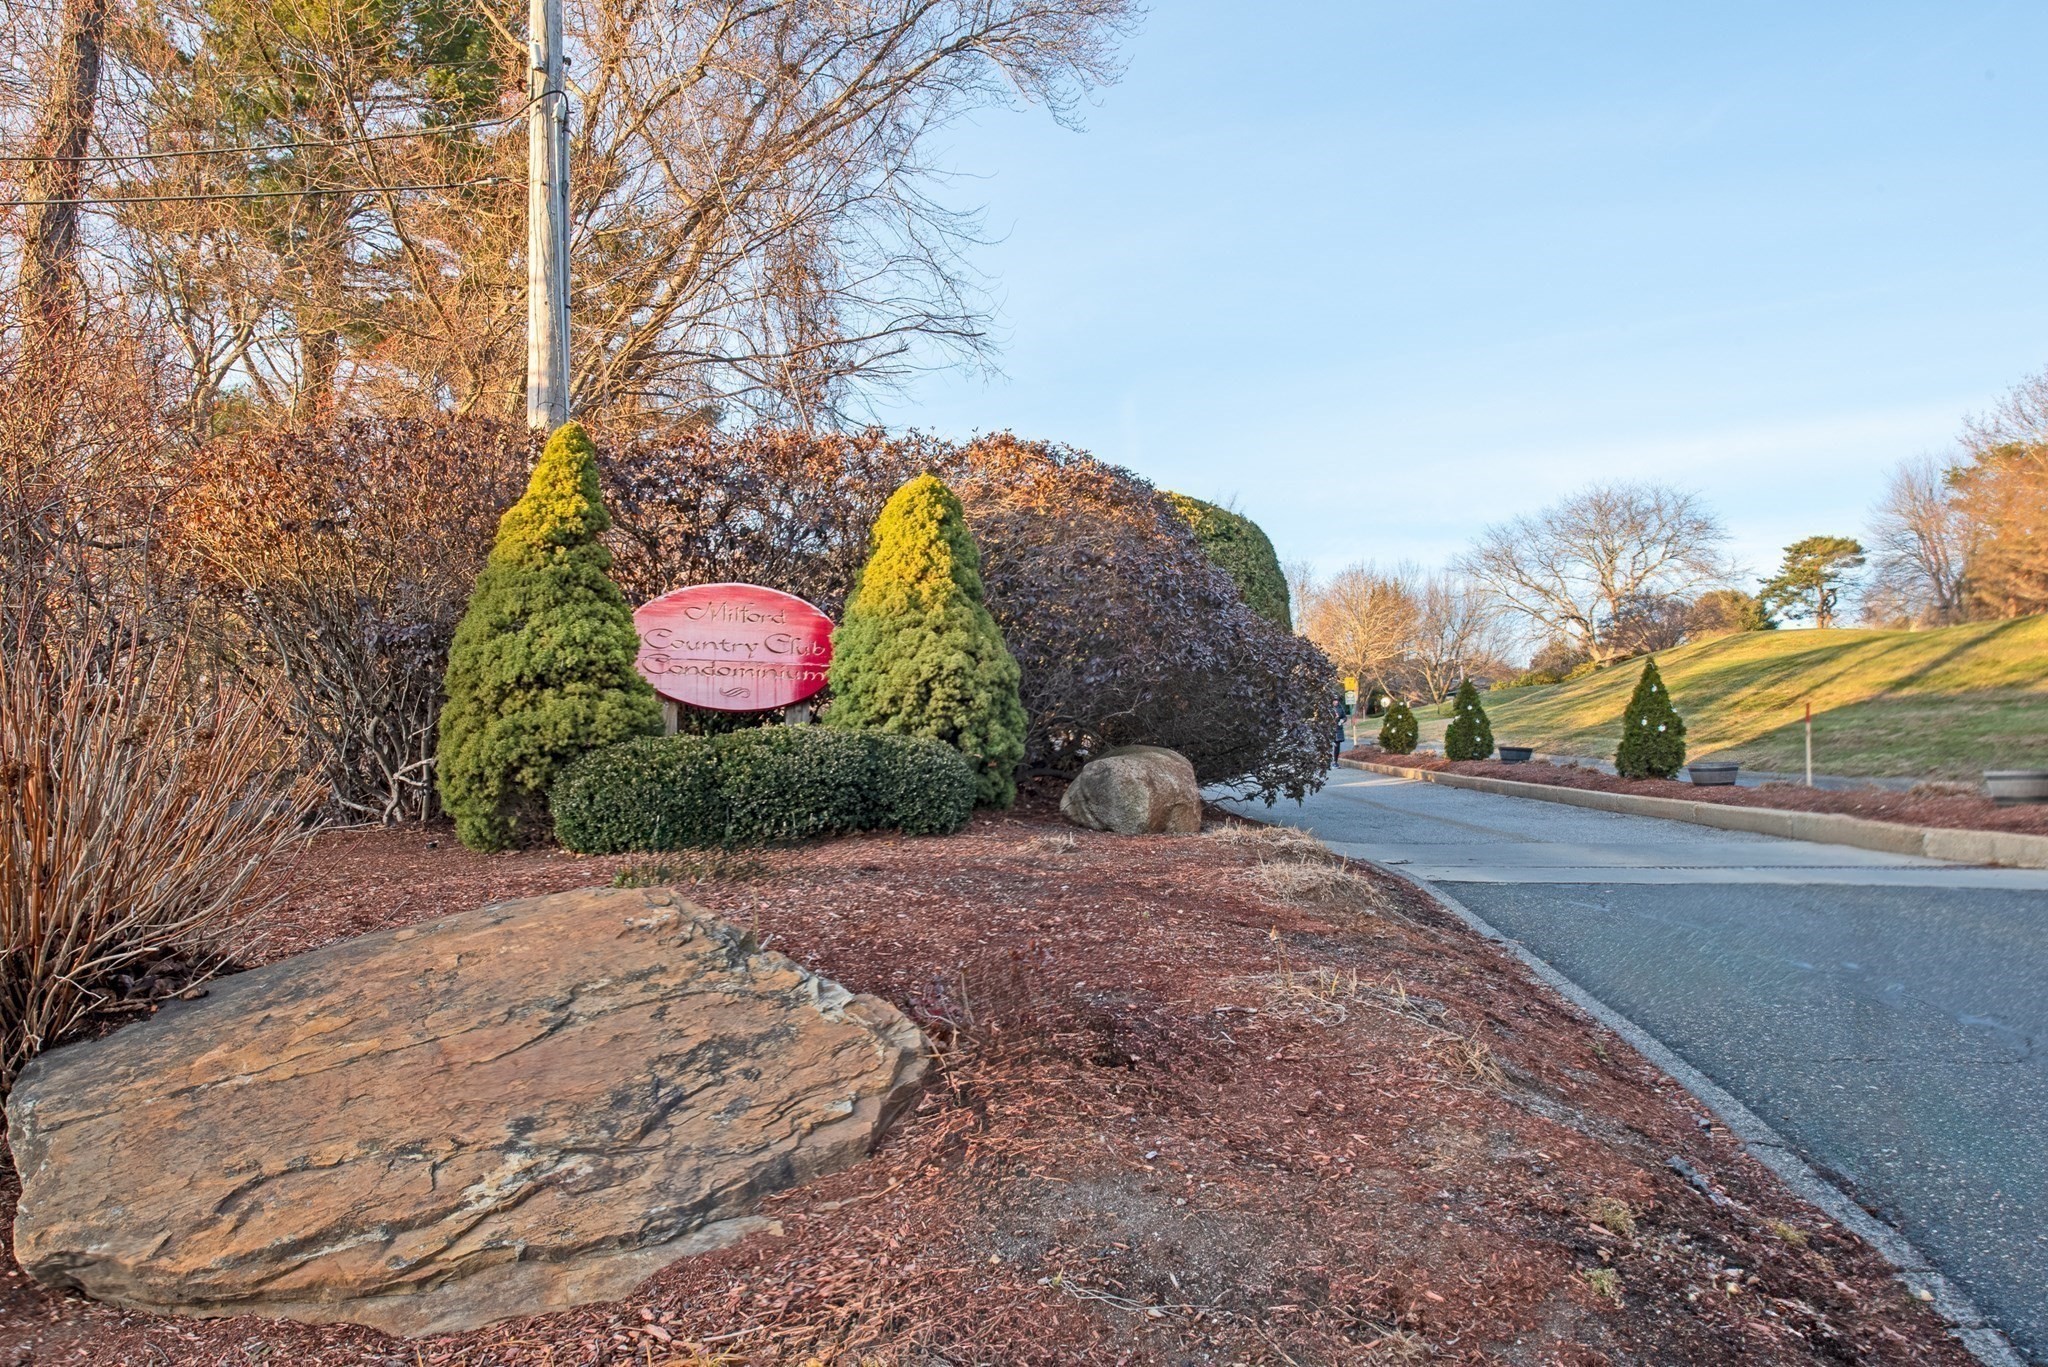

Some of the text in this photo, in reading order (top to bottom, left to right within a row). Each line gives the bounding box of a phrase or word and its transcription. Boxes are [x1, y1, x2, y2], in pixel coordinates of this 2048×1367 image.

[684, 601, 786, 625] Milford
[644, 628, 825, 658] Country Club
[642, 653, 825, 681] Condominium
